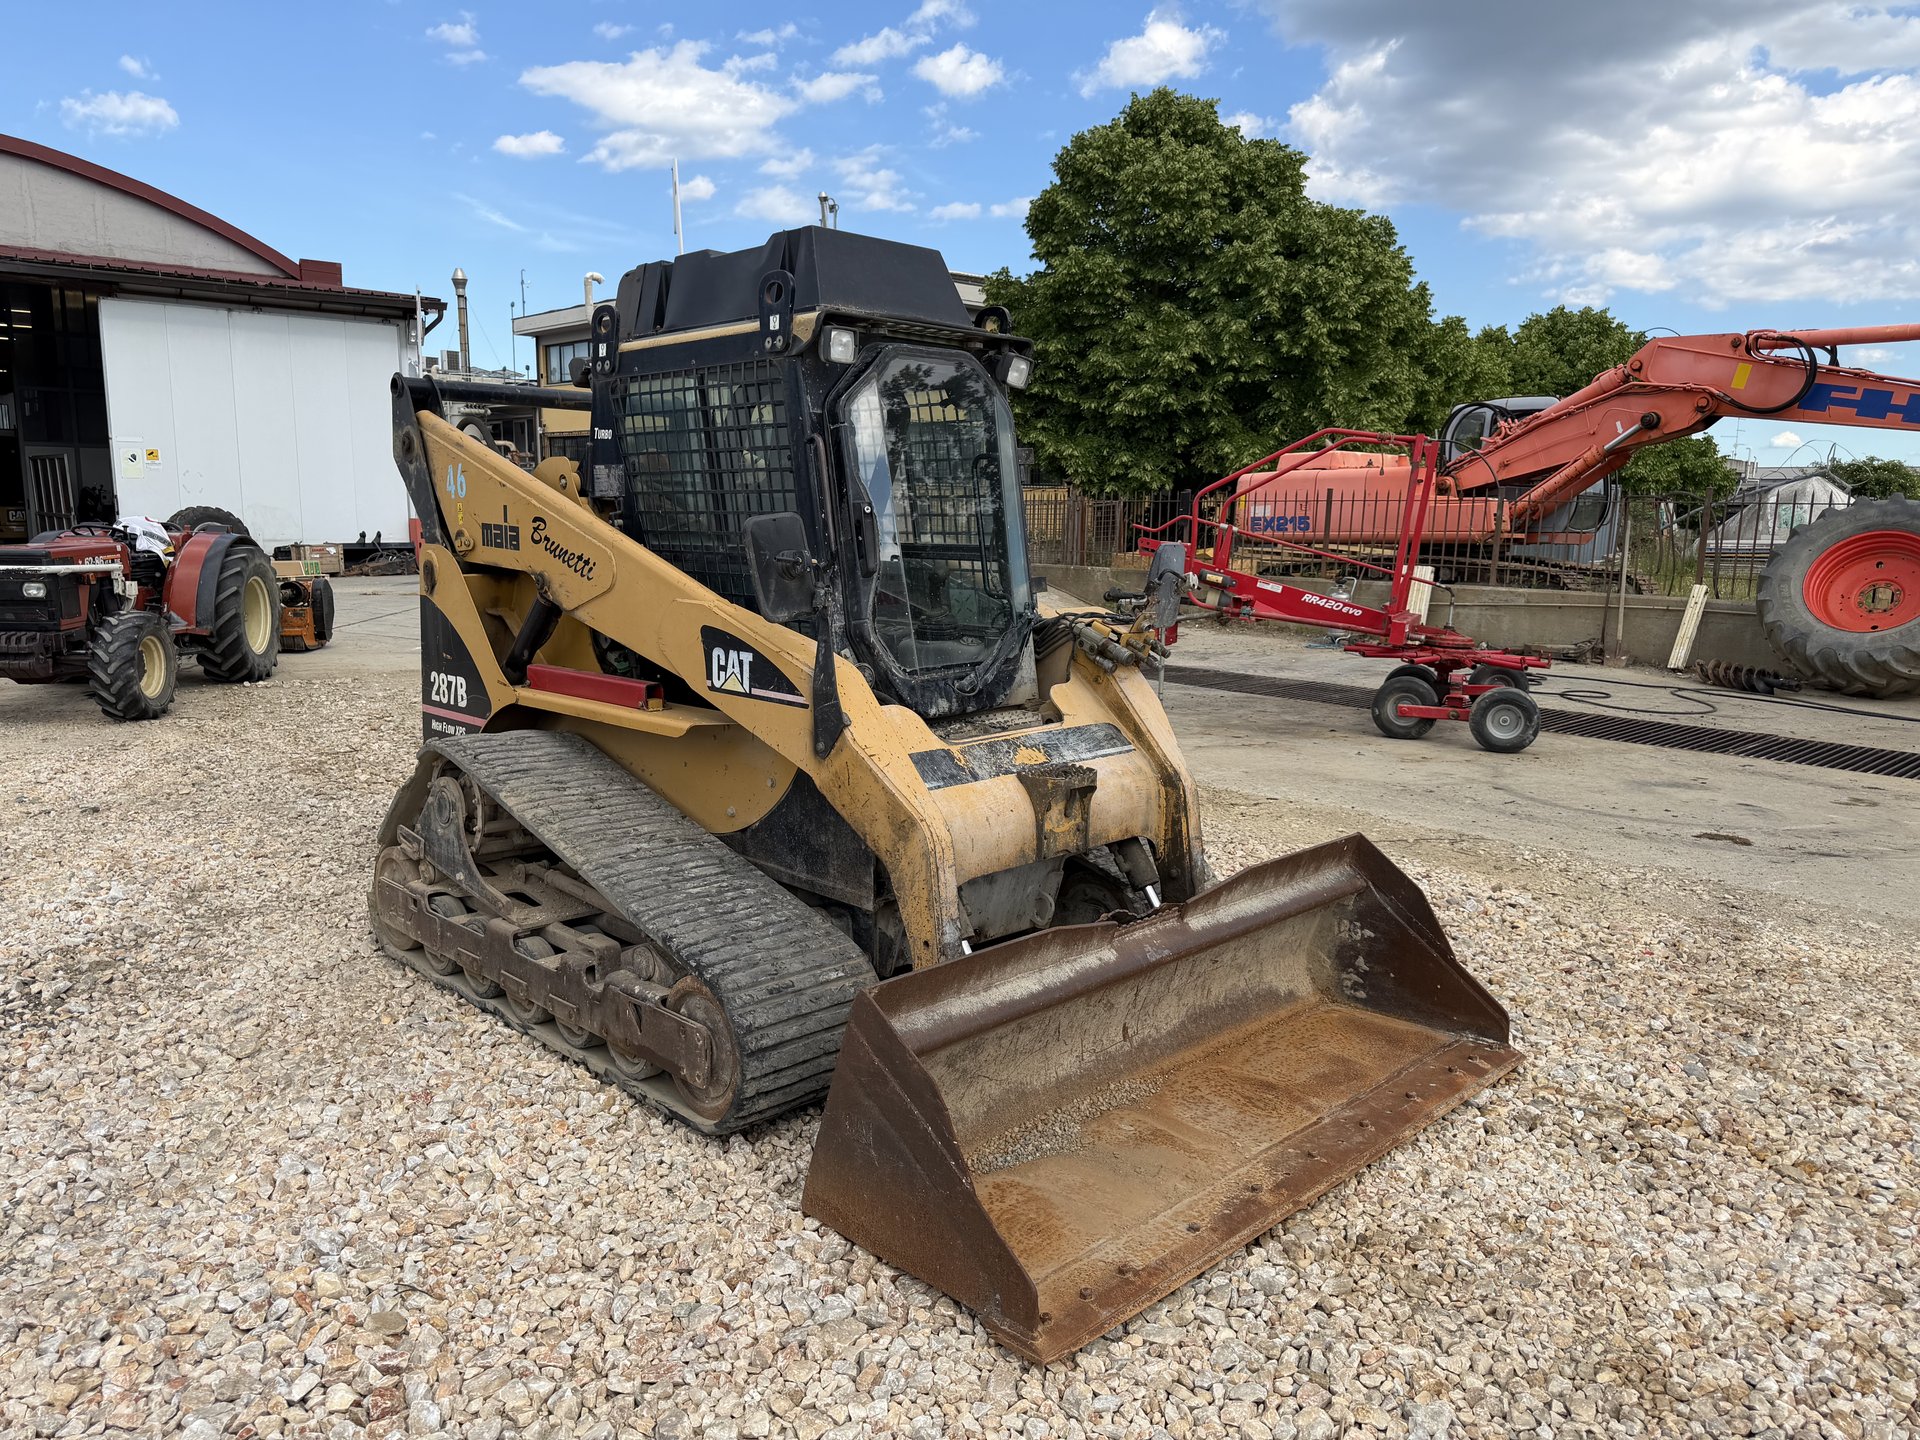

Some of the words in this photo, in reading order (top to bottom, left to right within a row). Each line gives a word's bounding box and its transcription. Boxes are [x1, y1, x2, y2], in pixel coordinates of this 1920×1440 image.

[594, 427, 613, 440] TURBO
[446, 463, 467, 499] 46
[1250, 515, 1310, 532] EX215
[530, 516, 597, 581] Brunetti
[1301, 593, 1344, 611] RR420
[1341, 606, 1363, 617] evo
[712, 646, 753, 694] CAT
[430, 670, 468, 708] 287B
[442, 721, 456, 736] FLOW
[455, 725, 467, 737] XPS
